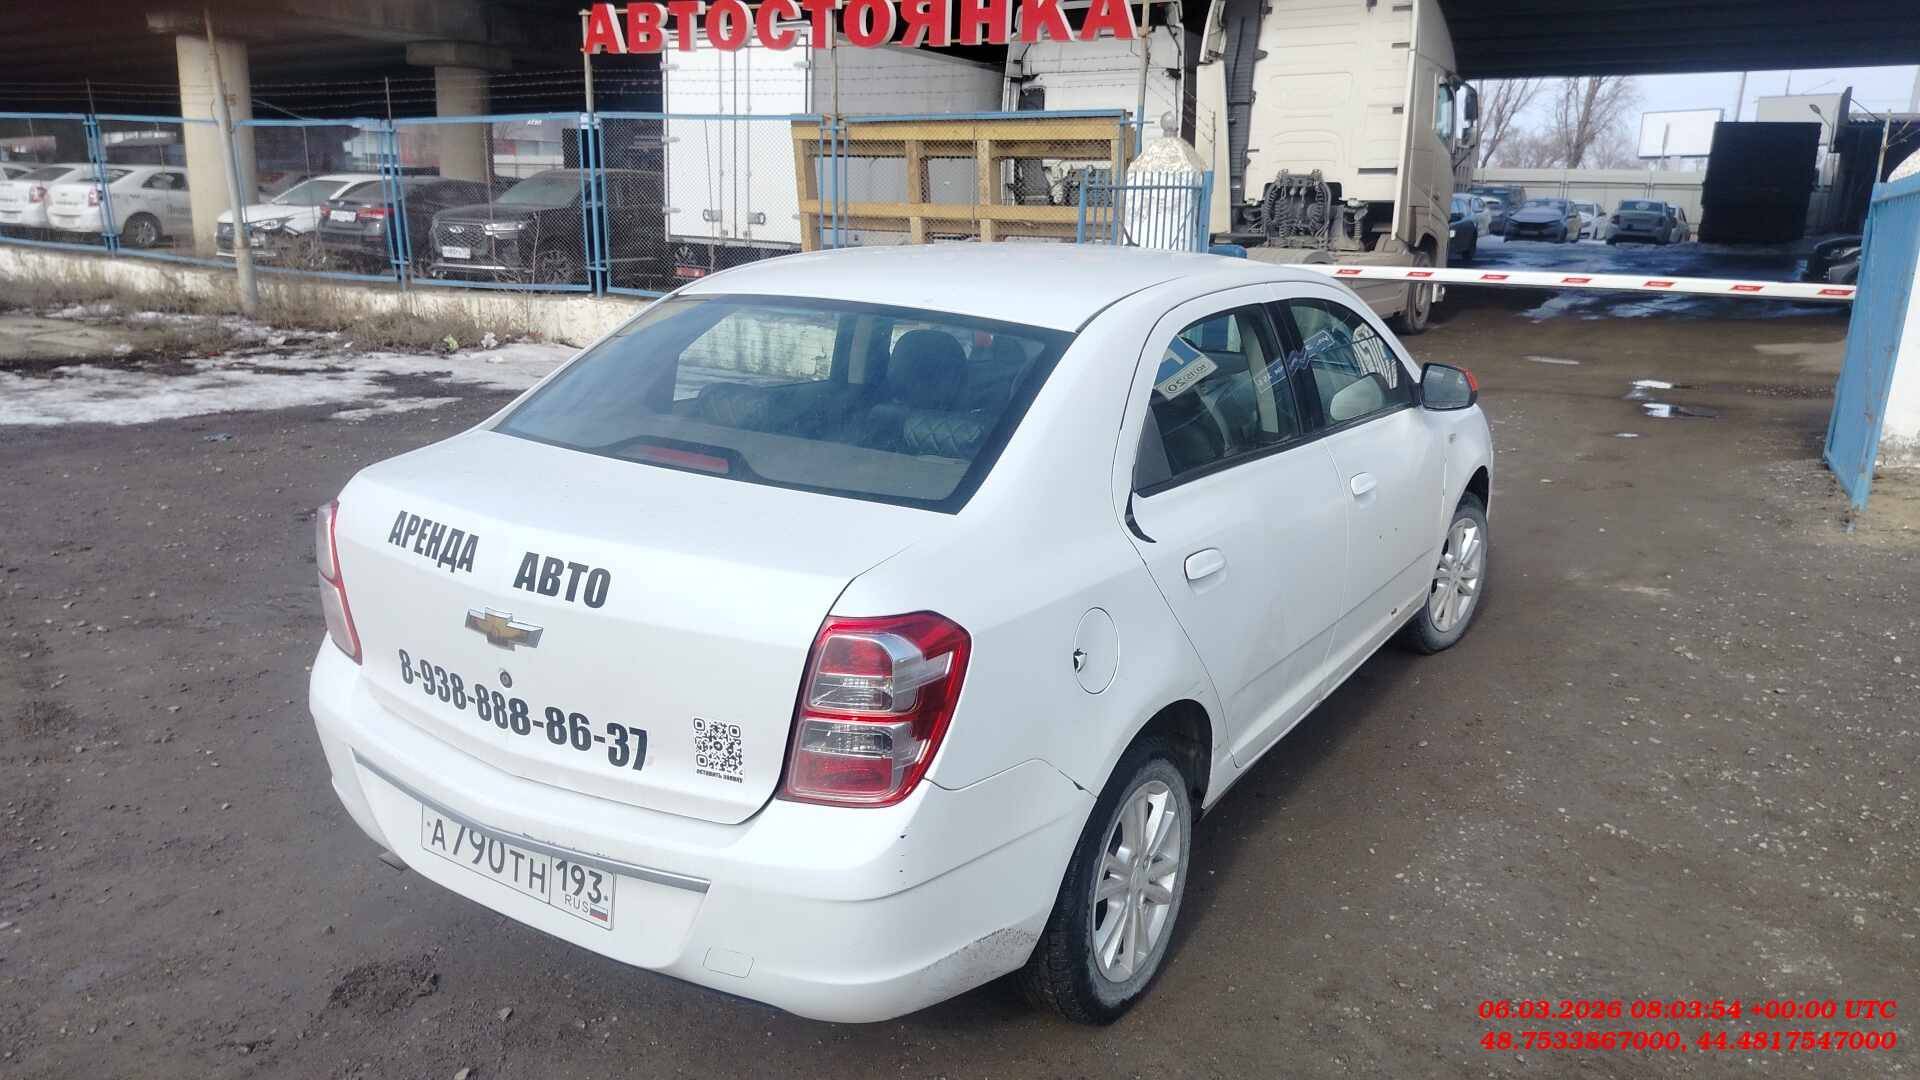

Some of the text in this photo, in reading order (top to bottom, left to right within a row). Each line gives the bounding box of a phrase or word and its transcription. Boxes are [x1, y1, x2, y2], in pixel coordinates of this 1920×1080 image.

[585, 0, 1137, 54] АВТОСТОЯНКА
[389, 510, 611, 609] АРЕНДА АВТО
[398, 648, 648, 771] 8-938-888-86-37
[555, 860, 602, 904] 193
[564, 893, 590, 914] RUS
